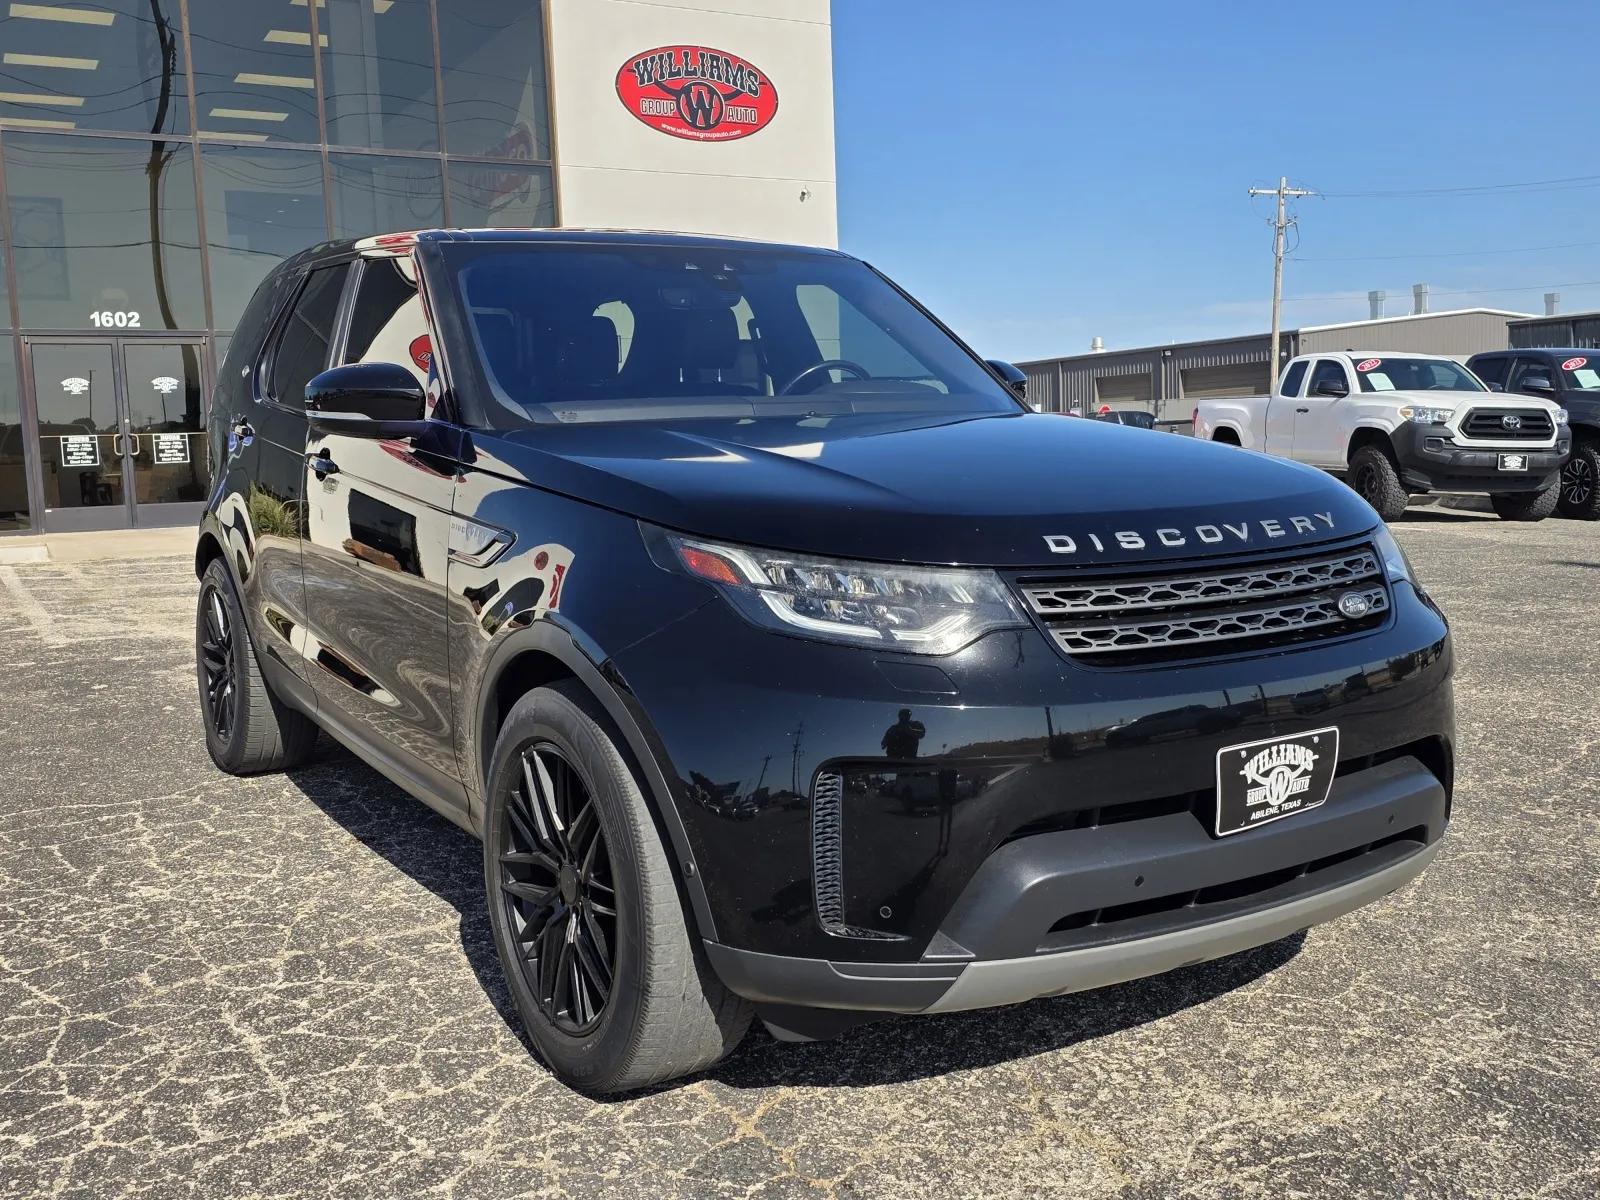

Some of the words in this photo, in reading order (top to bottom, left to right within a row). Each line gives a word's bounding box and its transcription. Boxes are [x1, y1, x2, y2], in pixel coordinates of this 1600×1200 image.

[634, 50, 760, 97] WILLIAMS
[640, 99, 676, 116] GROUP
[727, 107, 757, 122] AUTO
[661, 123, 741, 138] www.williamsgroupauto.com
[90, 311, 141, 328] 1602
[1043, 511, 1335, 553] DISCOVERY
[1244, 743, 1314, 784] WILLIAMS
[1291, 778, 1310, 793] AUTO
[1250, 805, 1280, 821] ABILENE,
[1281, 799, 1302, 812] TEXAS
